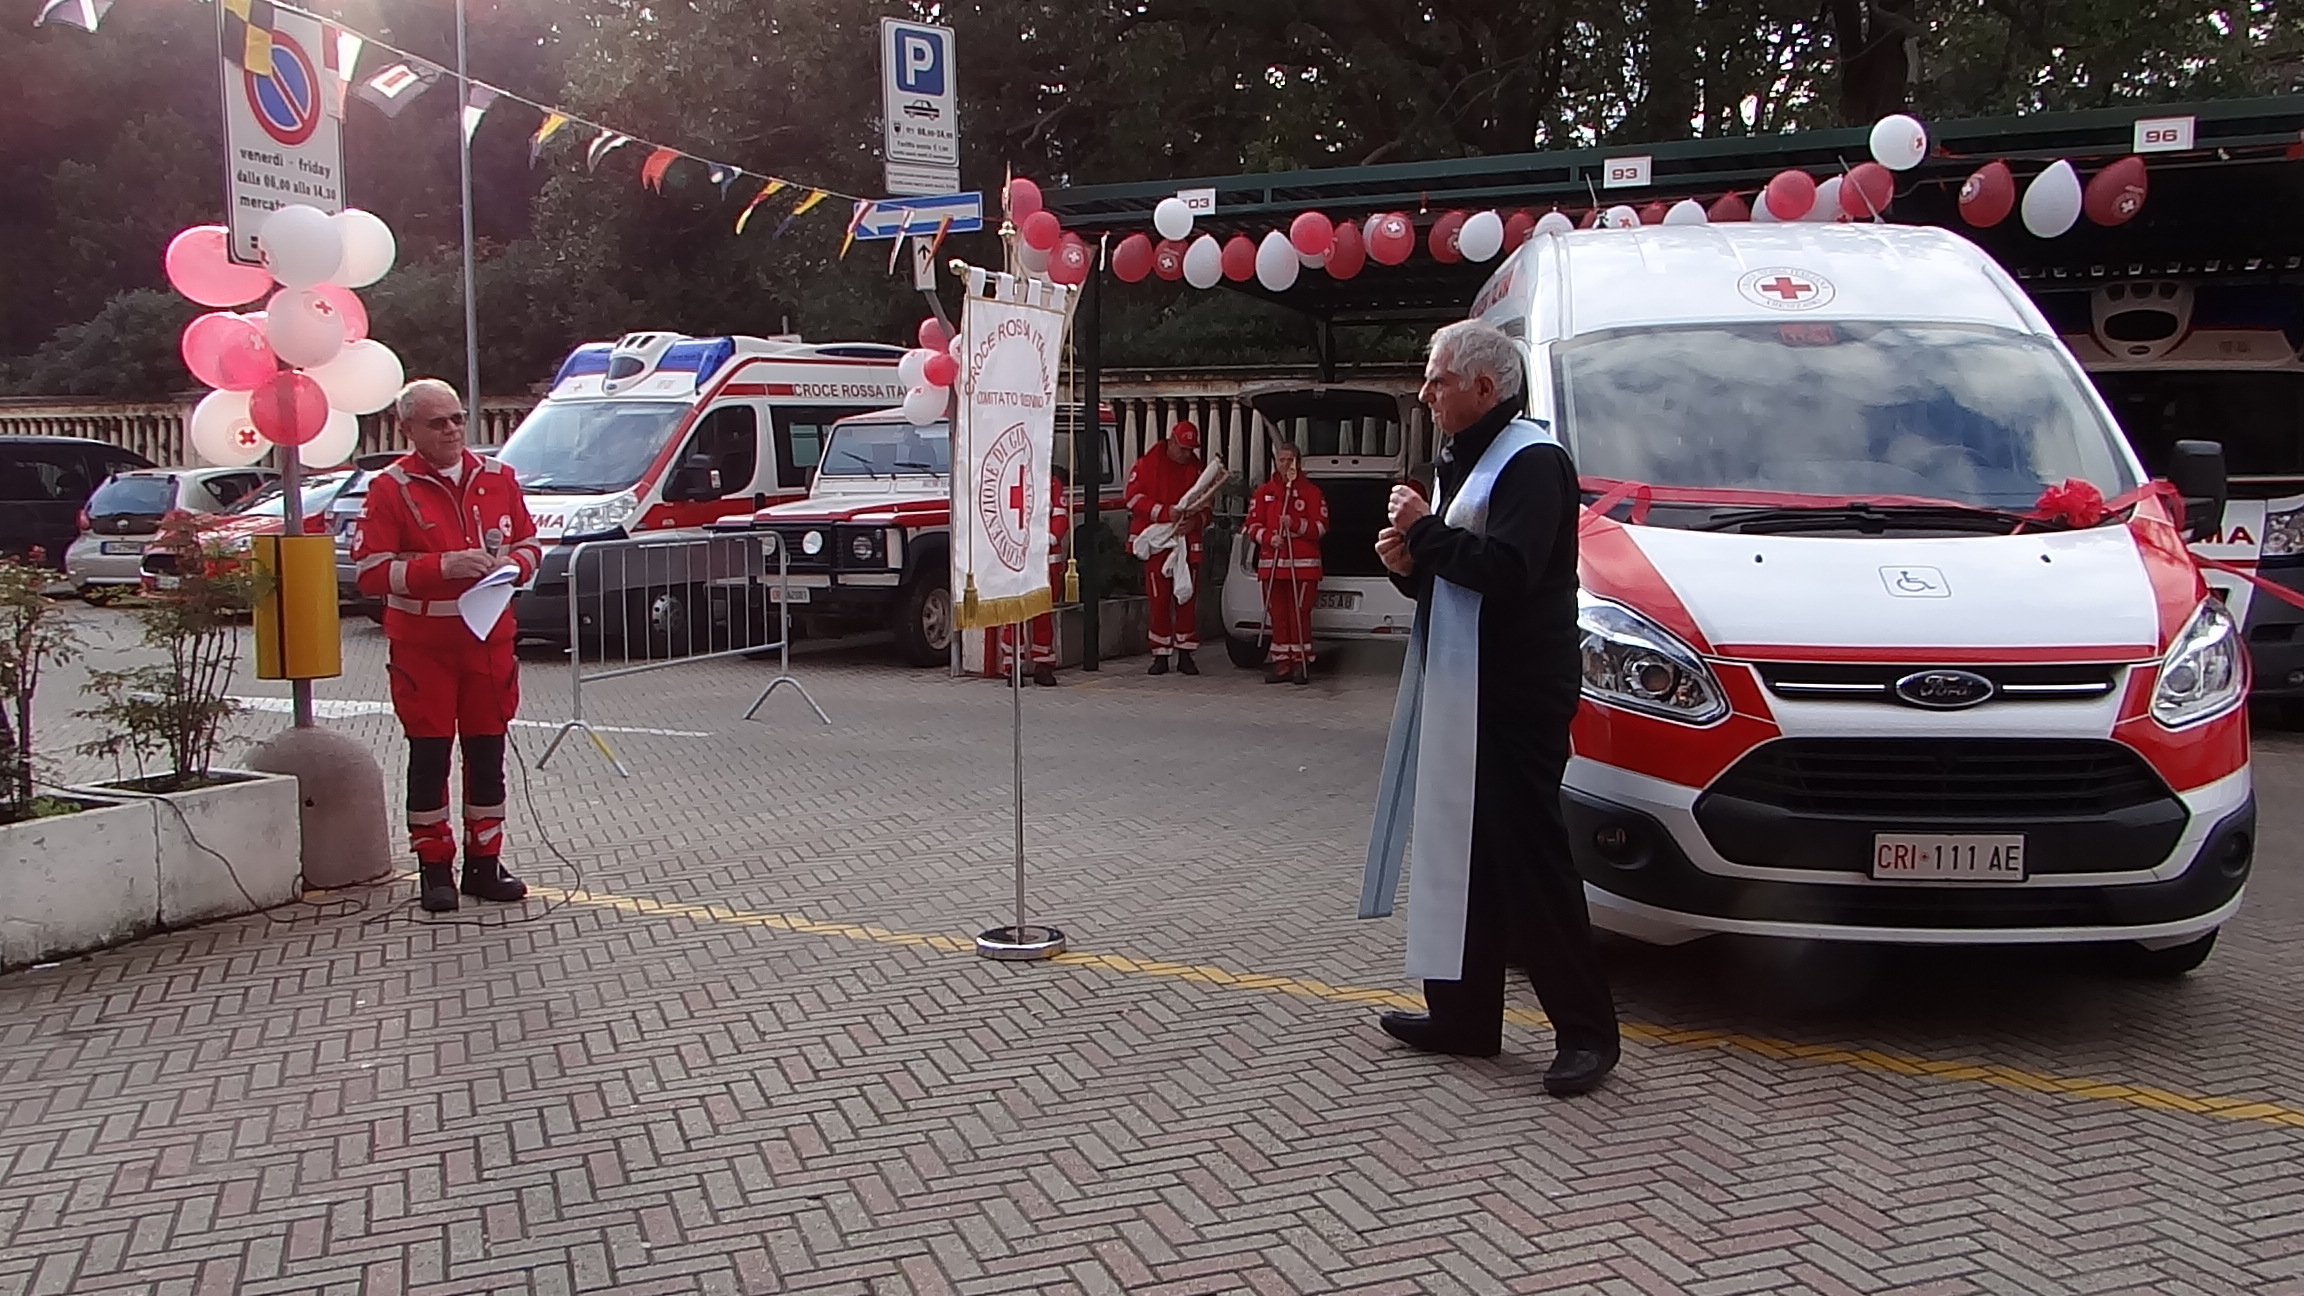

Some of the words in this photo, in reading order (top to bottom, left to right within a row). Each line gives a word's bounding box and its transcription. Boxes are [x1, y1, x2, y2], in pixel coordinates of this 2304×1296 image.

[904, 36, 935, 87] P
[2145, 129, 2178, 143] 96
[298, 157, 331, 180] friday
[1612, 167, 1638, 180] 93
[1182, 197, 1210, 209] 03
[794, 383, 838, 397] CROCE
[841, 384, 885, 398] ROSSA
[1920, 675, 1973, 697] Ford
[1877, 844, 1917, 870] CRI
[1934, 845, 1976, 870] 111
[1988, 845, 2020, 871] AE
